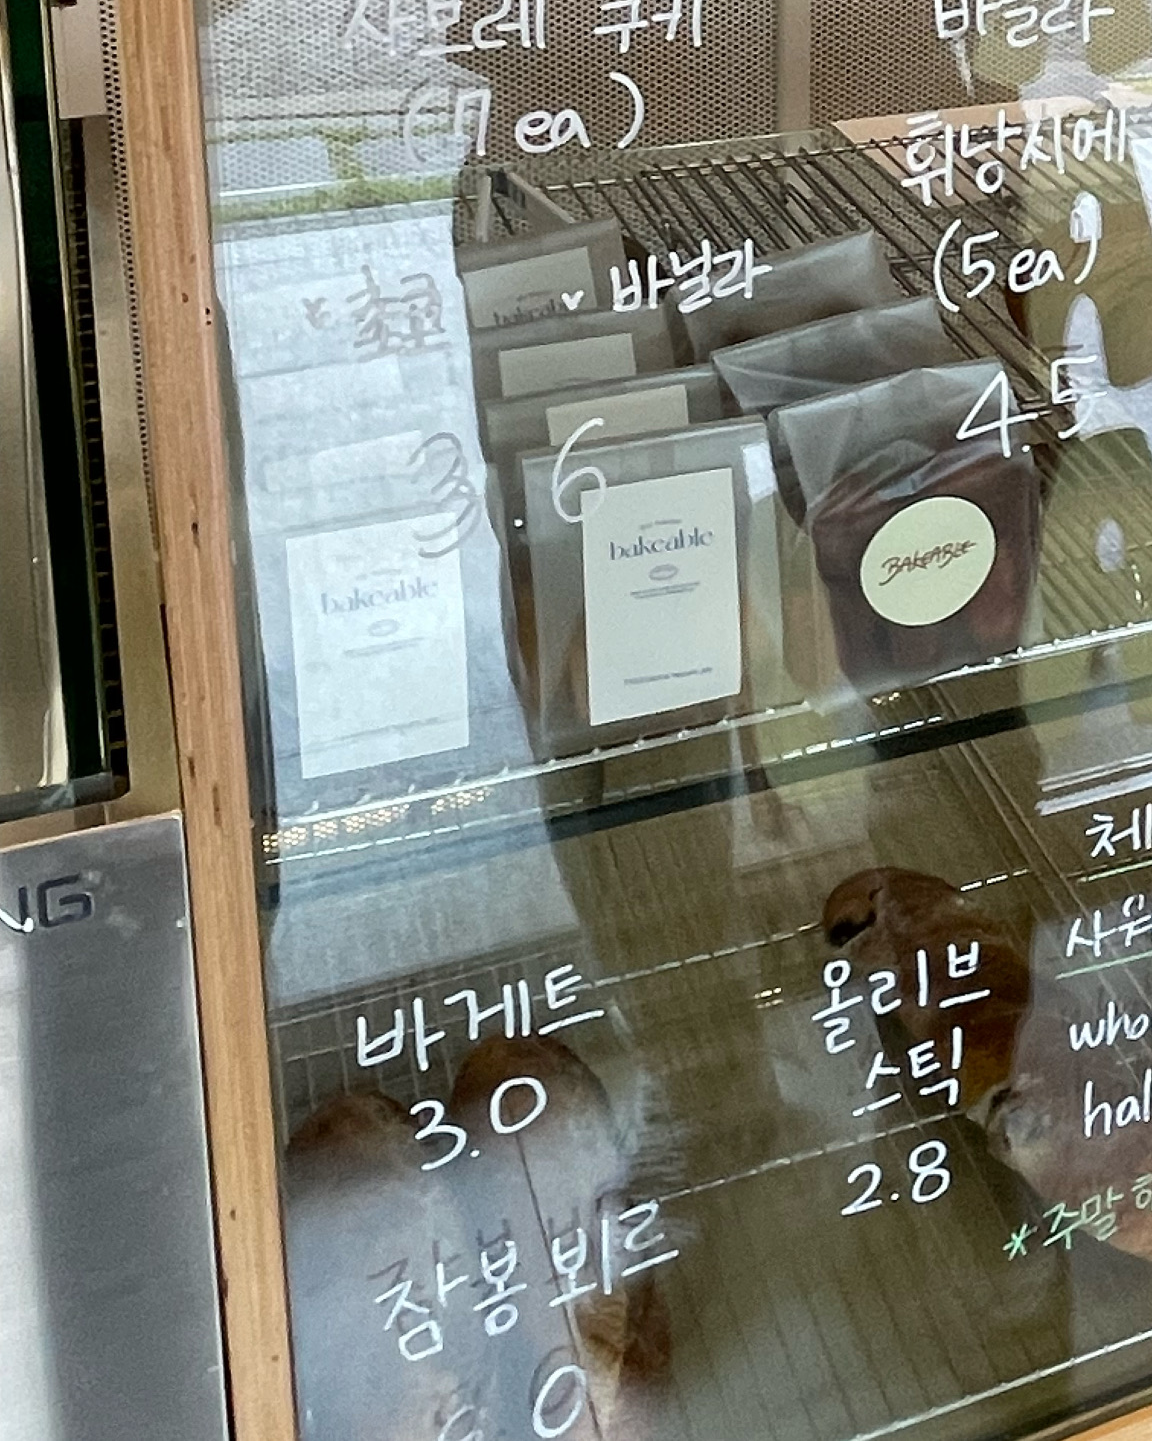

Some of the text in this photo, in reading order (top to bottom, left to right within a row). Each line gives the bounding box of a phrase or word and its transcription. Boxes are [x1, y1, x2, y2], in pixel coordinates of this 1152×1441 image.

[902, 108, 1128, 206] 휘낭시에
[610, 239, 774, 313] 바닐라
[957, 356, 1109, 458] 4.5
[608, 525, 714, 561] bakeable
[357, 964, 605, 1071] 바게트
[812, 941, 990, 1054] 올리브
[853, 1027, 964, 1115] 스틱
[409, 1077, 547, 1171] 3.0
[841, 1140, 951, 1217] 2.8
